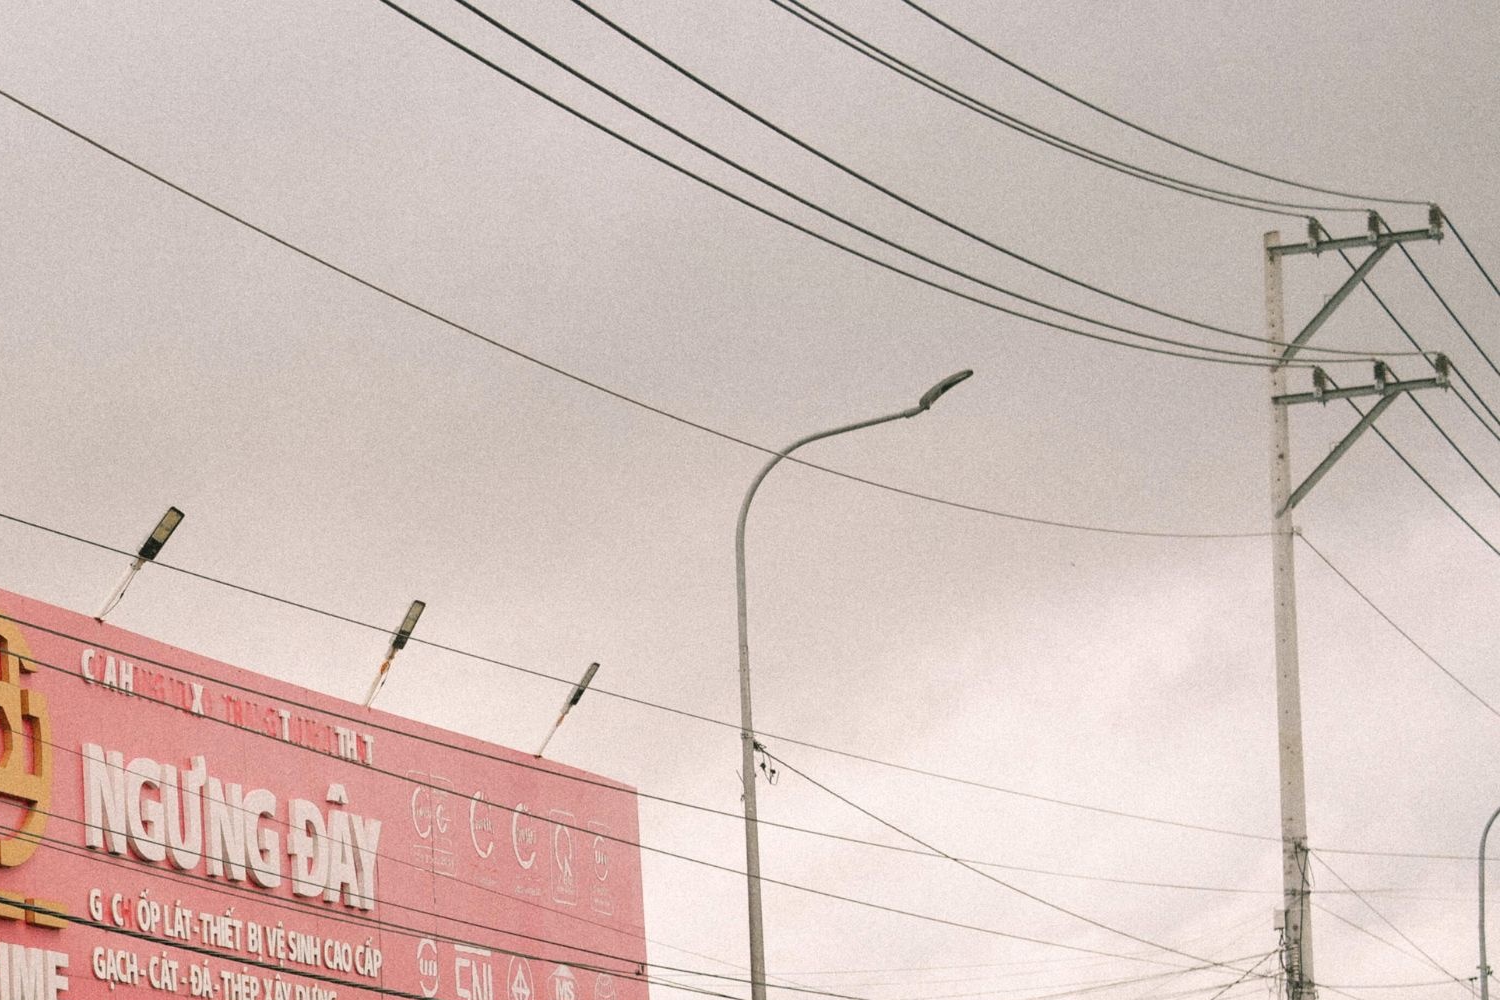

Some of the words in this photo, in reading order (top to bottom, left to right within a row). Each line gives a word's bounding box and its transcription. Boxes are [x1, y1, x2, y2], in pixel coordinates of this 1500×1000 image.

[81, 742, 280, 889] NGƯNG
[287, 782, 382, 912] ĐÂY
[93, 946, 139, 990] GẠCH
[149, 952, 179, 992] CÁT
[190, 960, 213, 1000] ĐÁ
[137, 889, 160, 933] ỐP
[164, 900, 193, 940] LÁT
[200, 907, 243, 950] THIẾT
[248, 921, 263, 961] BỊ
[265, 921, 286, 968] VỆ
[287, 931, 321, 966] SINH
[324, 939, 352, 973] CAO
[355, 937, 383, 978] CẤP
